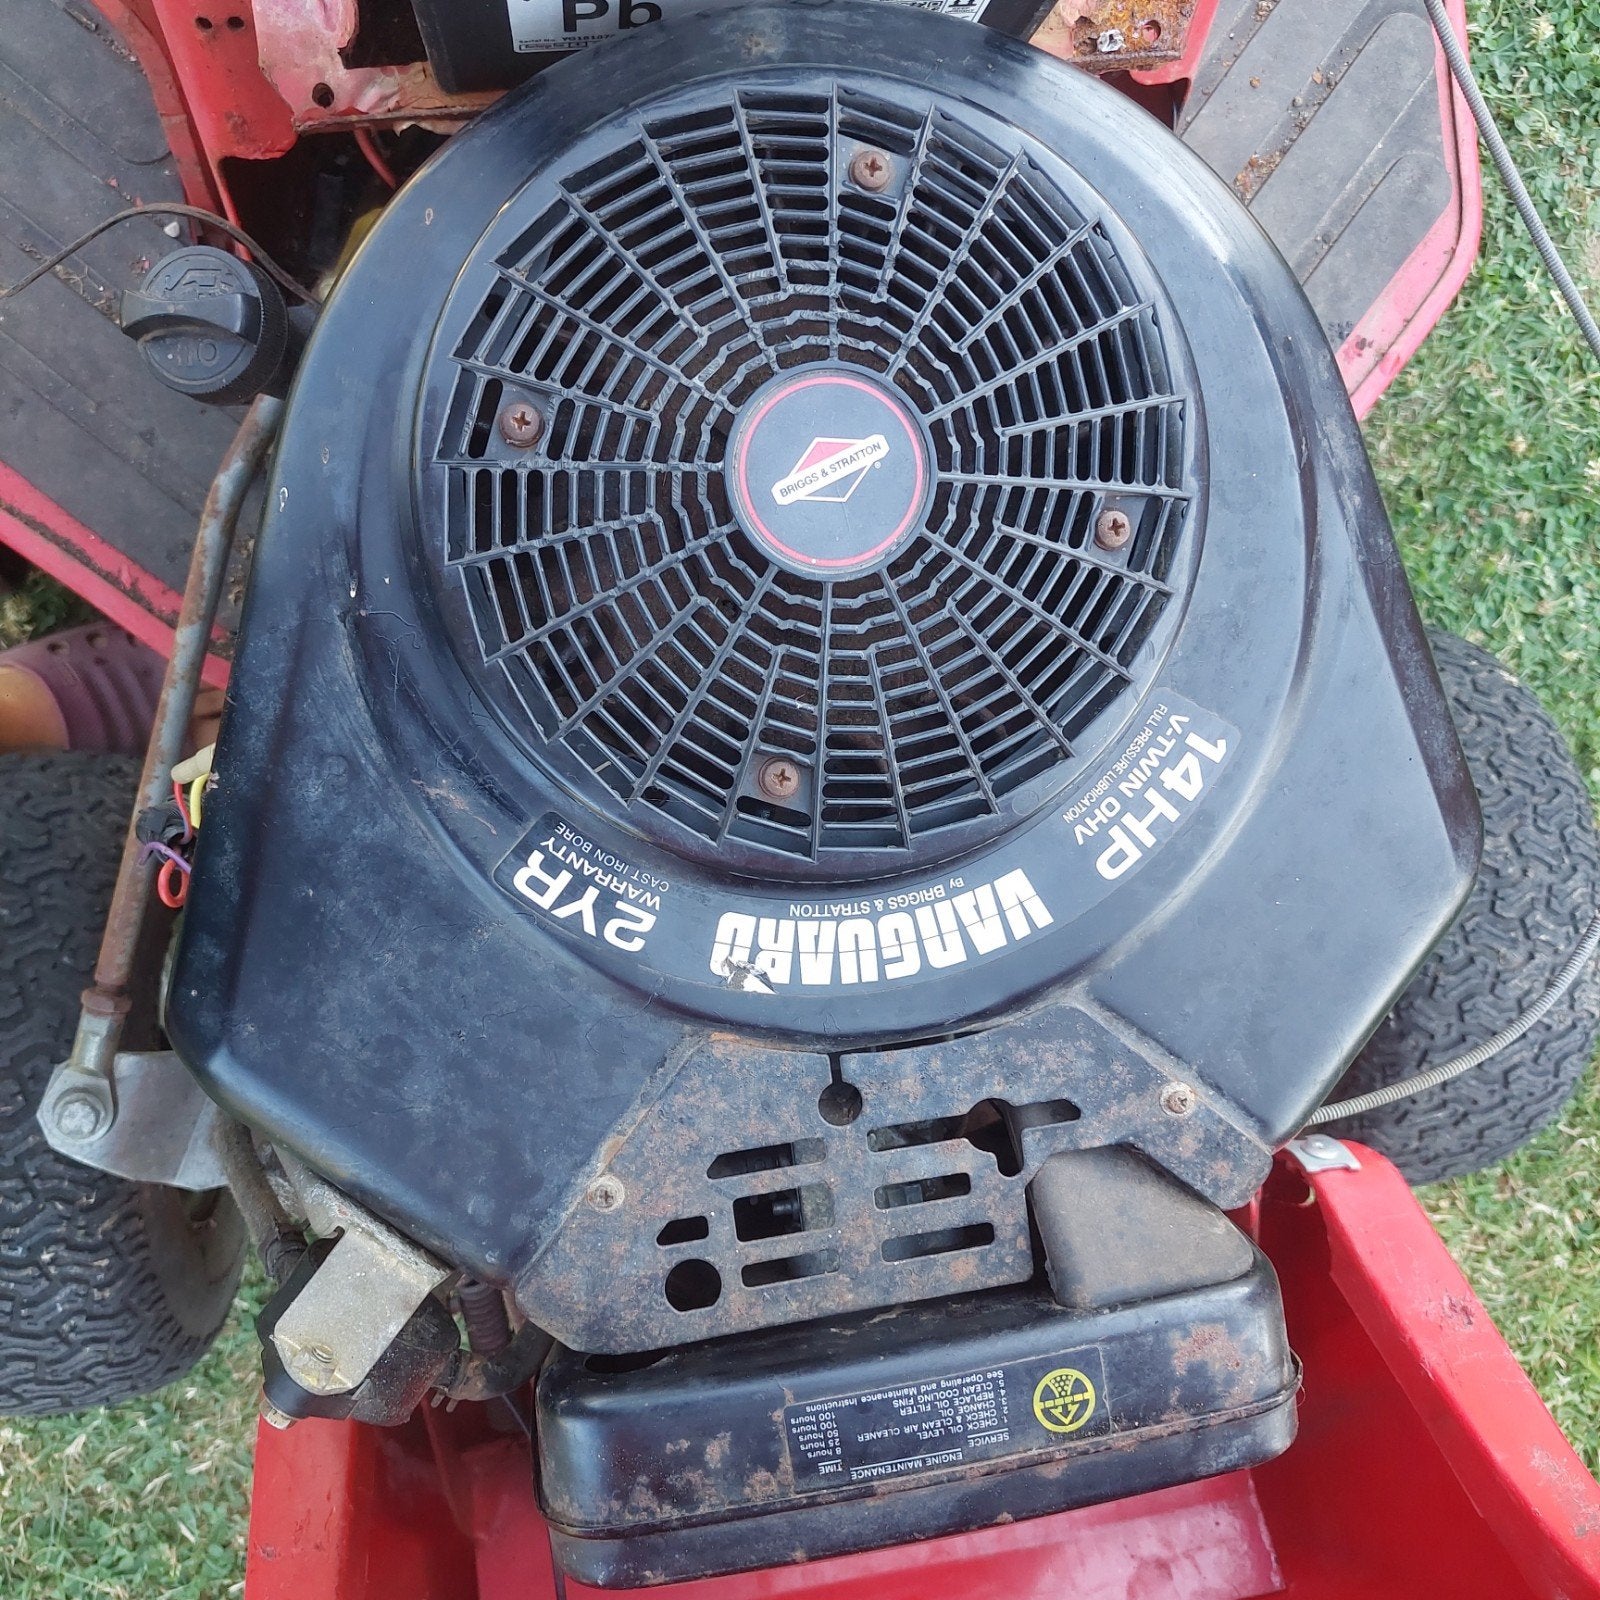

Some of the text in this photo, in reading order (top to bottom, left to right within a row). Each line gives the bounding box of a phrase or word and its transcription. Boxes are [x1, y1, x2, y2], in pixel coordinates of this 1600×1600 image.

[563, 0, 662, 32] Pb
[779, 442, 882, 498] BRIGGS & STRATTON
[1063, 704, 1168, 823] FULL PRESSURE LUBRICATION
[1074, 714, 1190, 845] V-TWIN OHV
[1096, 732, 1226, 880] 14HP
[554, 822, 669, 892] CAST IRON BORE
[540, 836, 661, 911] WARRANTY
[513, 849, 656, 952] 2YR
[789, 877, 964, 916] By BRIGGS & STRATTON
[709, 868, 1054, 986] VANGUARD
[805, 1370, 1003, 1412] See Operating and Maintenance Instructions
[892, 1379, 1004, 1407] 5. CLEAN COOLING FINS
[900, 1388, 1006, 1416] 4. REPLACE OIL FILTER
[958, 1400, 995, 1414] CHANGE
[791, 1412, 836, 1424] 100 hours
[939, 1408, 954, 1417] OIL
[966, 1409, 996, 1420] CHECK
[792, 1420, 837, 1434] 100 hours
[904, 1424, 918, 1433] AIR
[922, 1418, 952, 1429] CLEAN
[948, 1425, 963, 1434] OIL
[967, 1418, 998, 1430] CHECK
[799, 1429, 838, 1442] 50 hours
[857, 1428, 900, 1442] CLEANER
[917, 1428, 944, 1440] LEVEL
[968, 1433, 1009, 1447] SERVICE
[800, 1438, 840, 1450] 25 hours
[807, 1448, 832, 1458] hours
[818, 1463, 842, 1474] TIME
[850, 1452, 962, 1479] ENGINE MAINTENANCE
